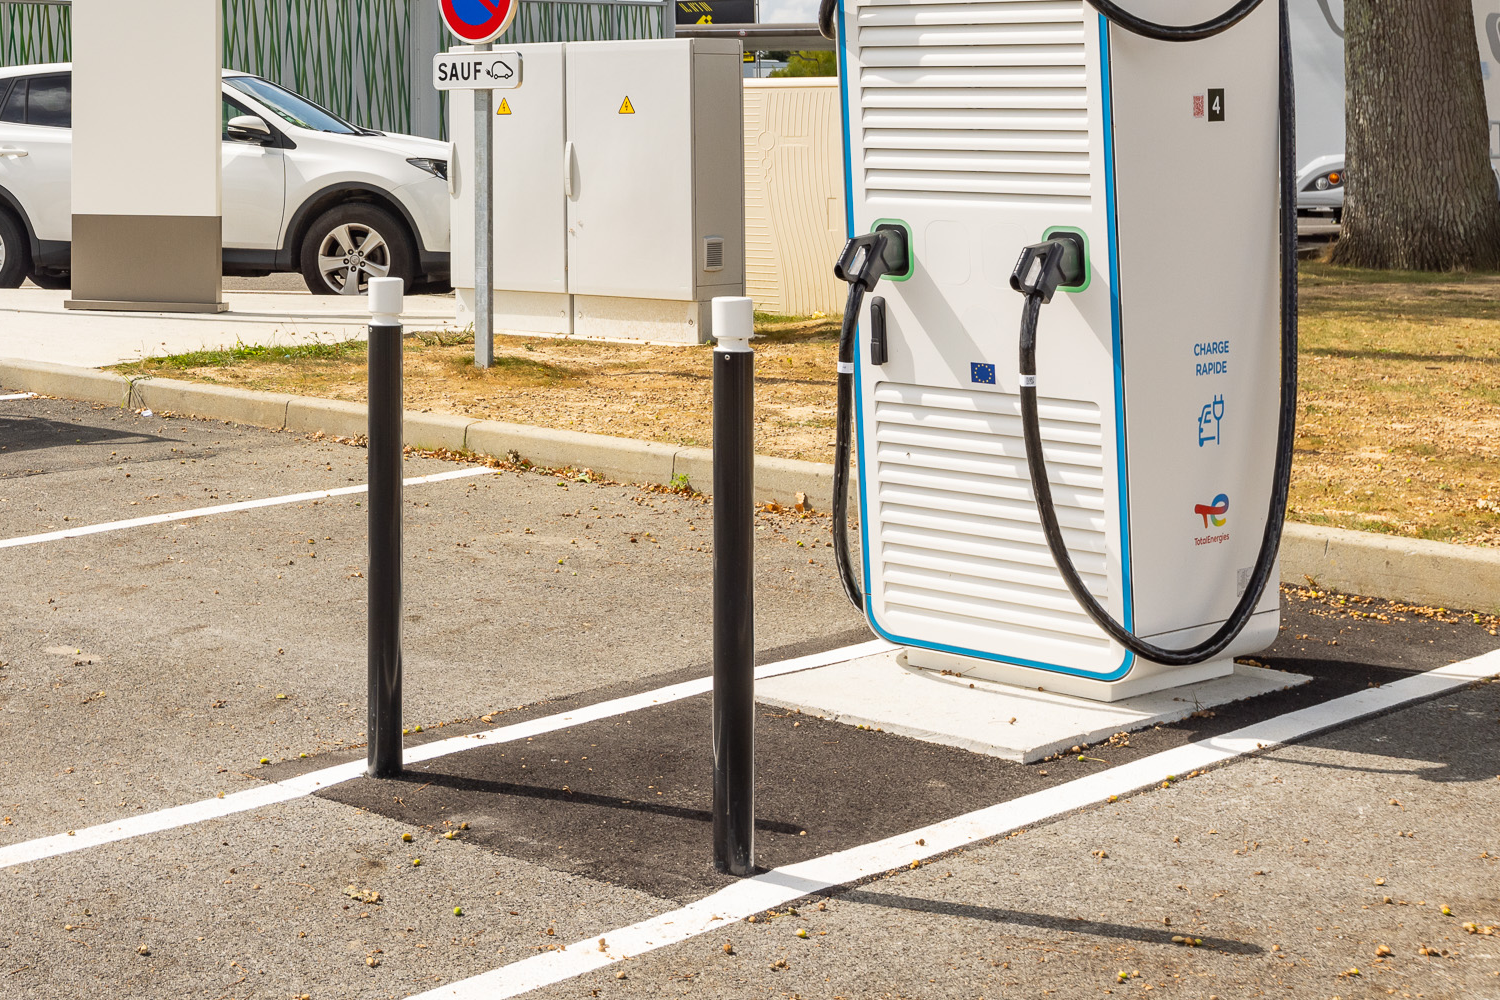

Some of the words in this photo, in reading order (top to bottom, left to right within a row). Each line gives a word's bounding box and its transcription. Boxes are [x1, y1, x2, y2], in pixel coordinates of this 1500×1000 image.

[438, 61, 483, 82] SAUF
[1212, 96, 1220, 114] 4
[1193, 340, 1230, 356] CHARGE
[1196, 360, 1228, 376] RAPIDE
[1194, 533, 1230, 546] TotalEnergies
